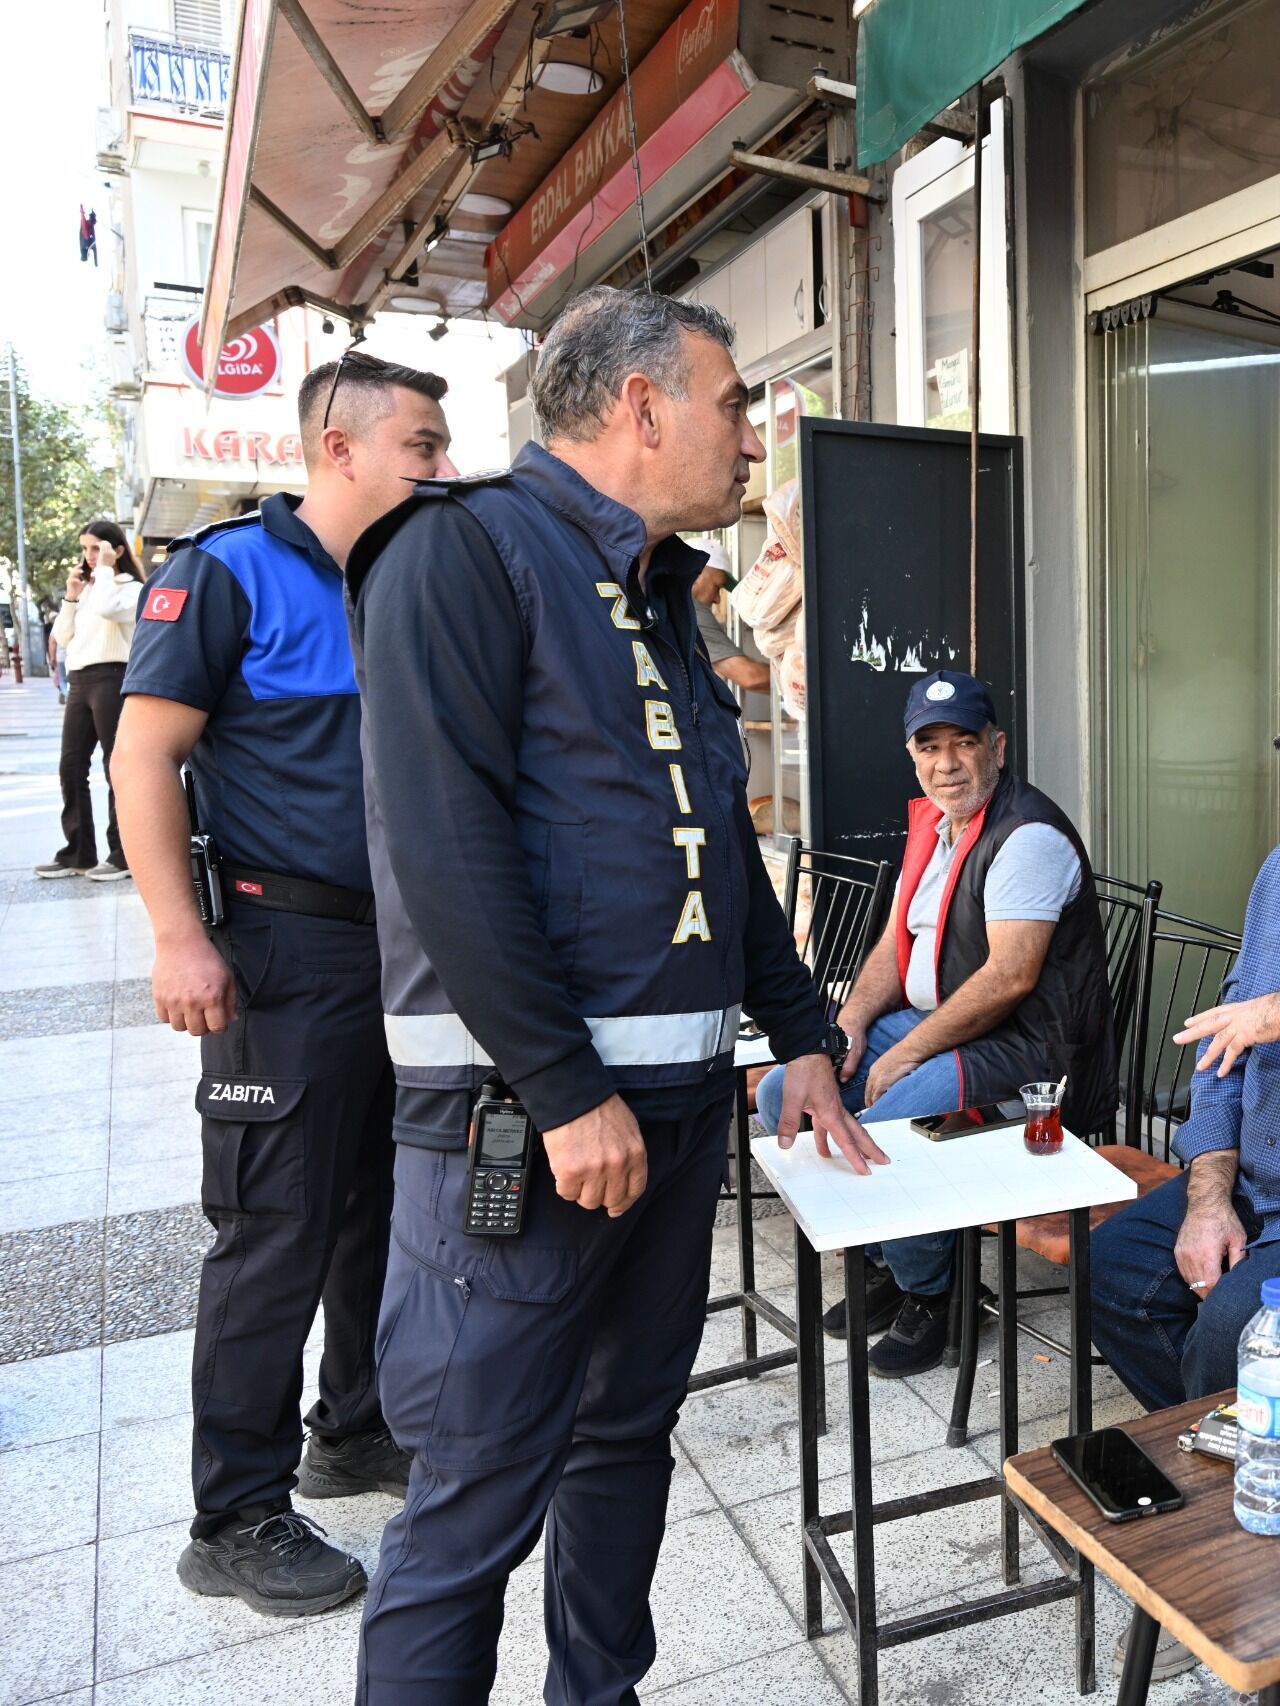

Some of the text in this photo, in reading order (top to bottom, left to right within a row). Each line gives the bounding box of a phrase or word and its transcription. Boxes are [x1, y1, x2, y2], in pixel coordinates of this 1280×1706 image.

[531, 168, 571, 245] ERDAL
[595, 582, 712, 944] ZABITA
[208, 1083, 276, 1105] ZABITA
